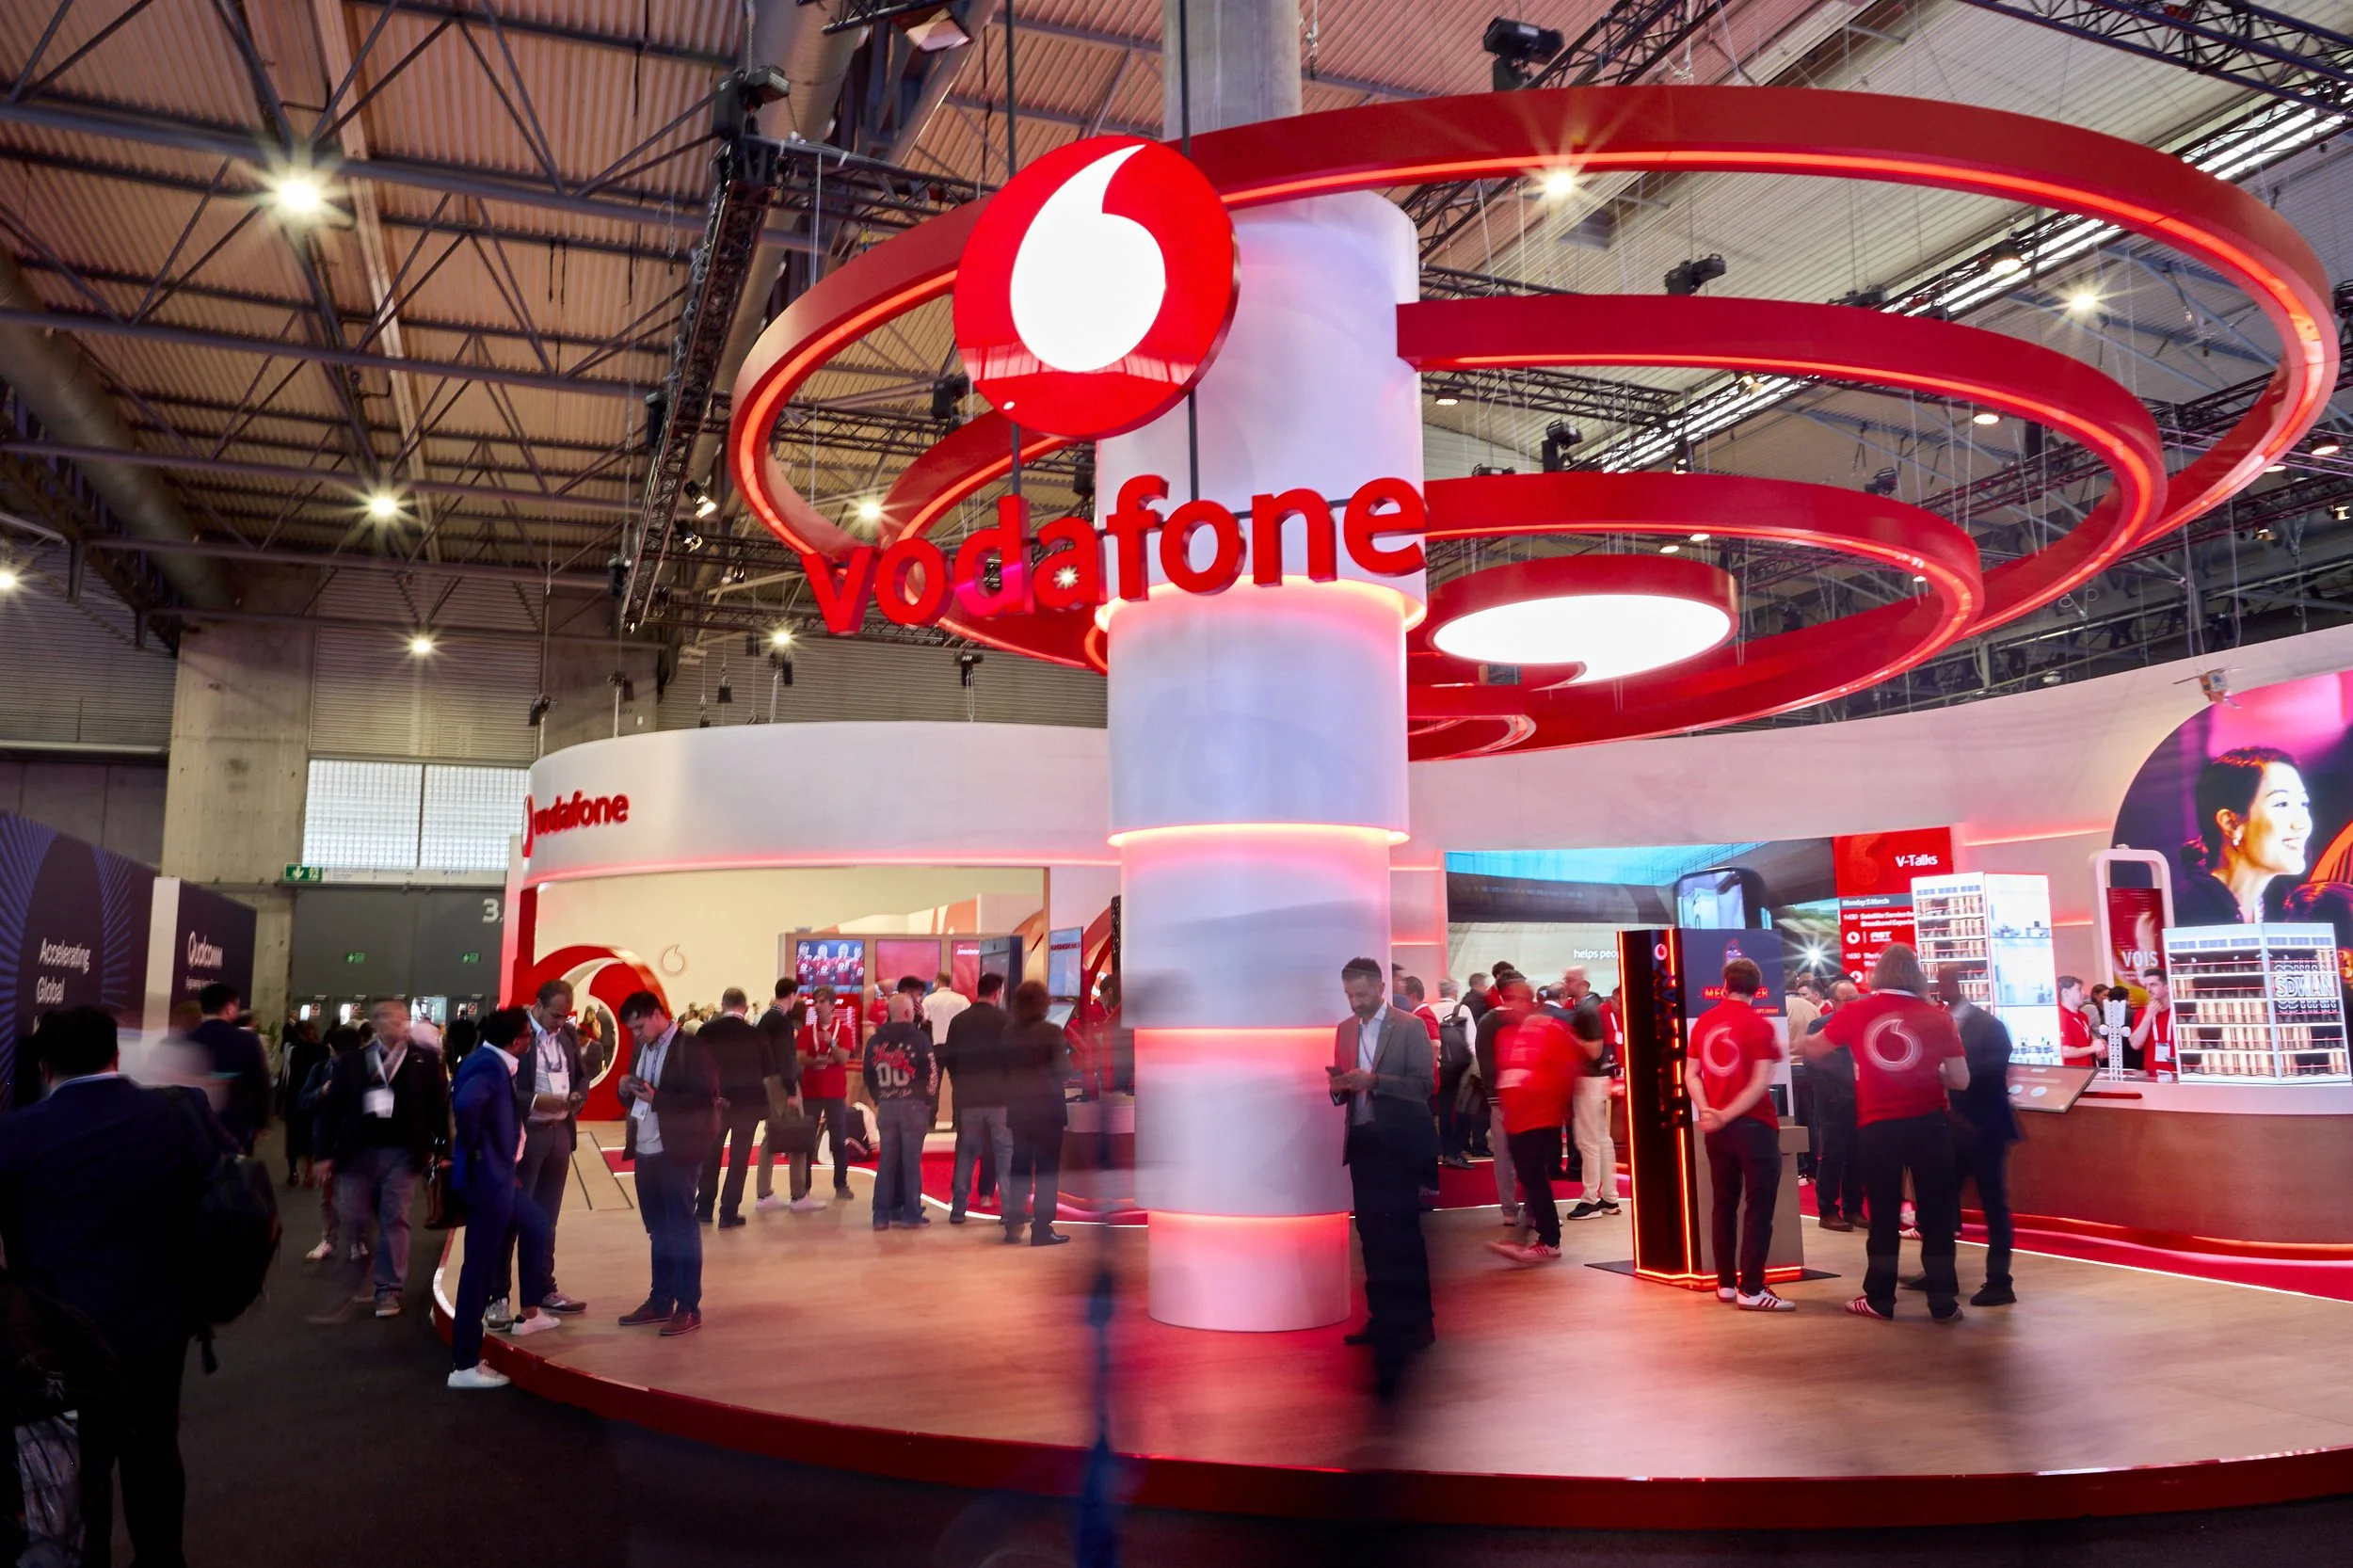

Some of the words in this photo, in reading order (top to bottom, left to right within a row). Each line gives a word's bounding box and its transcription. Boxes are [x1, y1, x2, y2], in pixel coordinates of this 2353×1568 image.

[801, 473, 1429, 634] vodafone
[534, 789, 629, 836] vodafone
[1895, 854, 1939, 868] V-Talks
[482, 898, 504, 923] 3
[1842, 899, 1865, 907] Monday
[1870, 897, 1890, 905] March
[39, 937, 91, 975] Accelerating
[187, 930, 223, 969] Qualcomm
[1573, 948, 1599, 960] helps
[2121, 950, 2159, 968] VOIS
[36, 976, 66, 1004] Global
[2275, 975, 2335, 998] SDWAN
